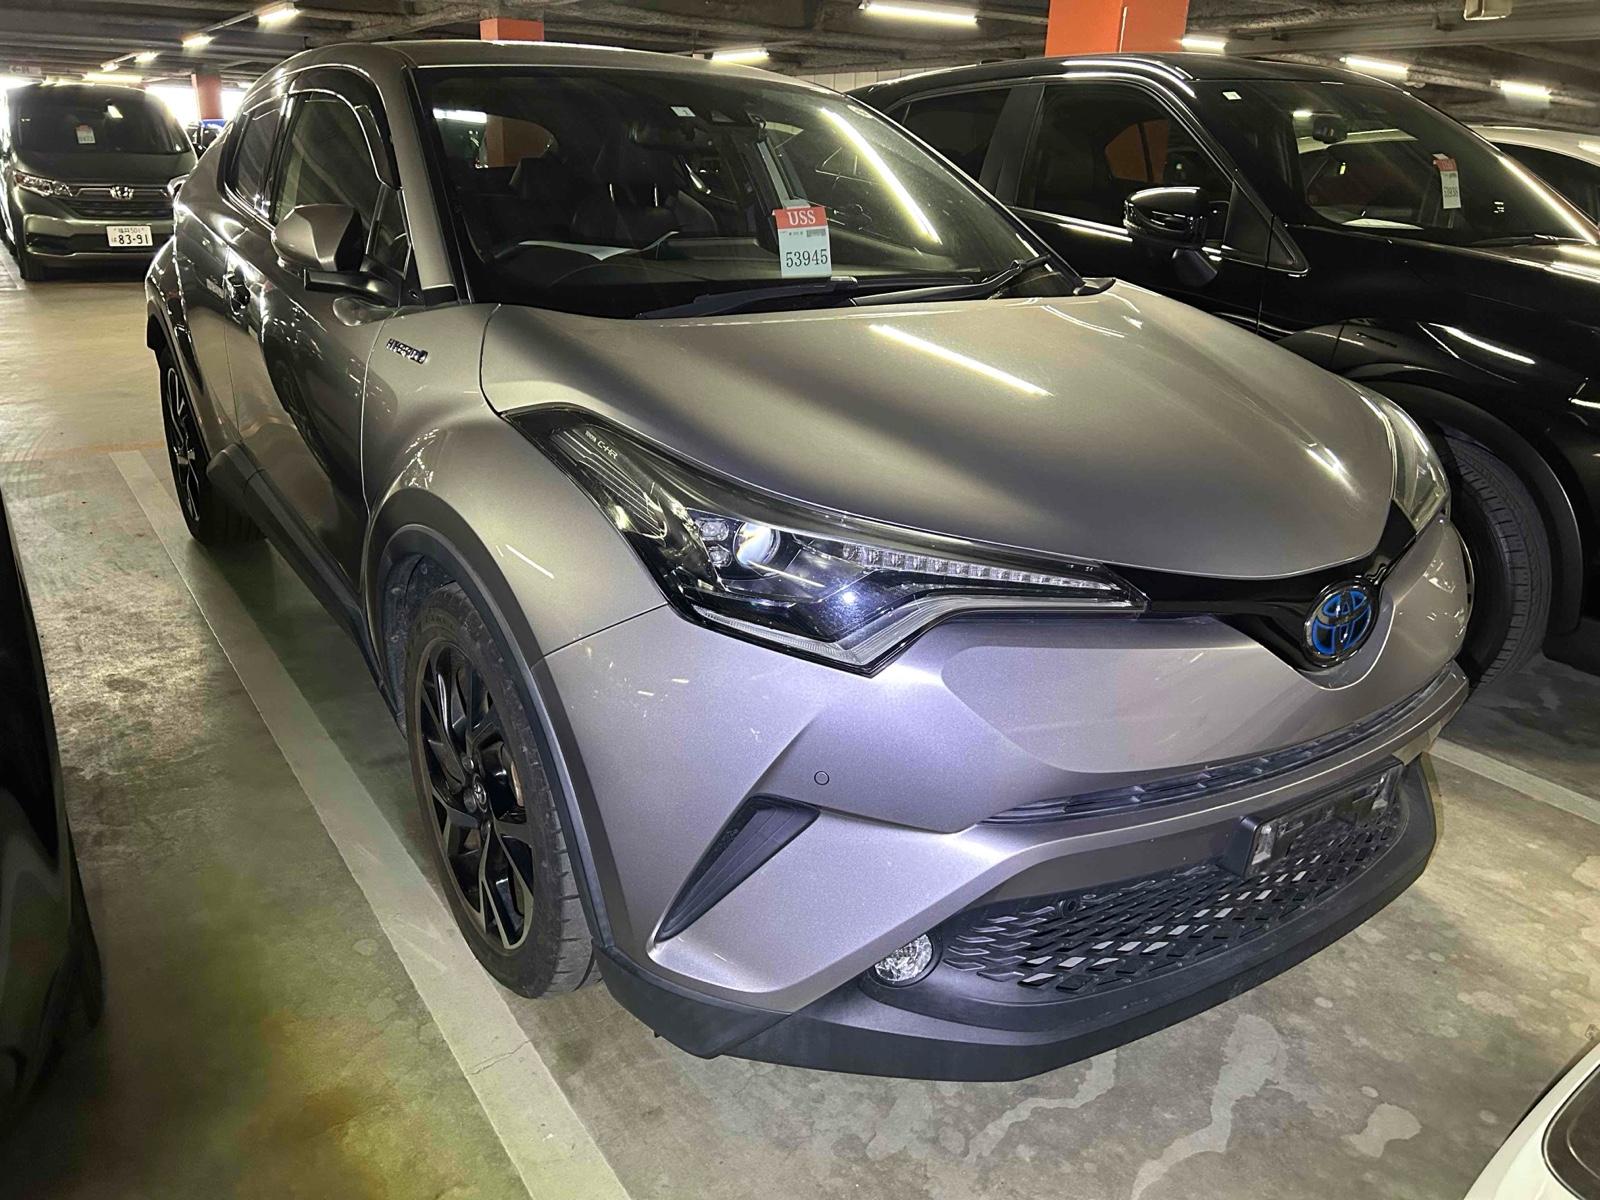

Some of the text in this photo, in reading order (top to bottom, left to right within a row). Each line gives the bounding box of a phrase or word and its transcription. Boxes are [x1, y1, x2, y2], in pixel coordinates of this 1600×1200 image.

[787, 209, 816, 226] USS
[118, 234, 149, 245] 83-91
[785, 248, 828, 268] 53945
